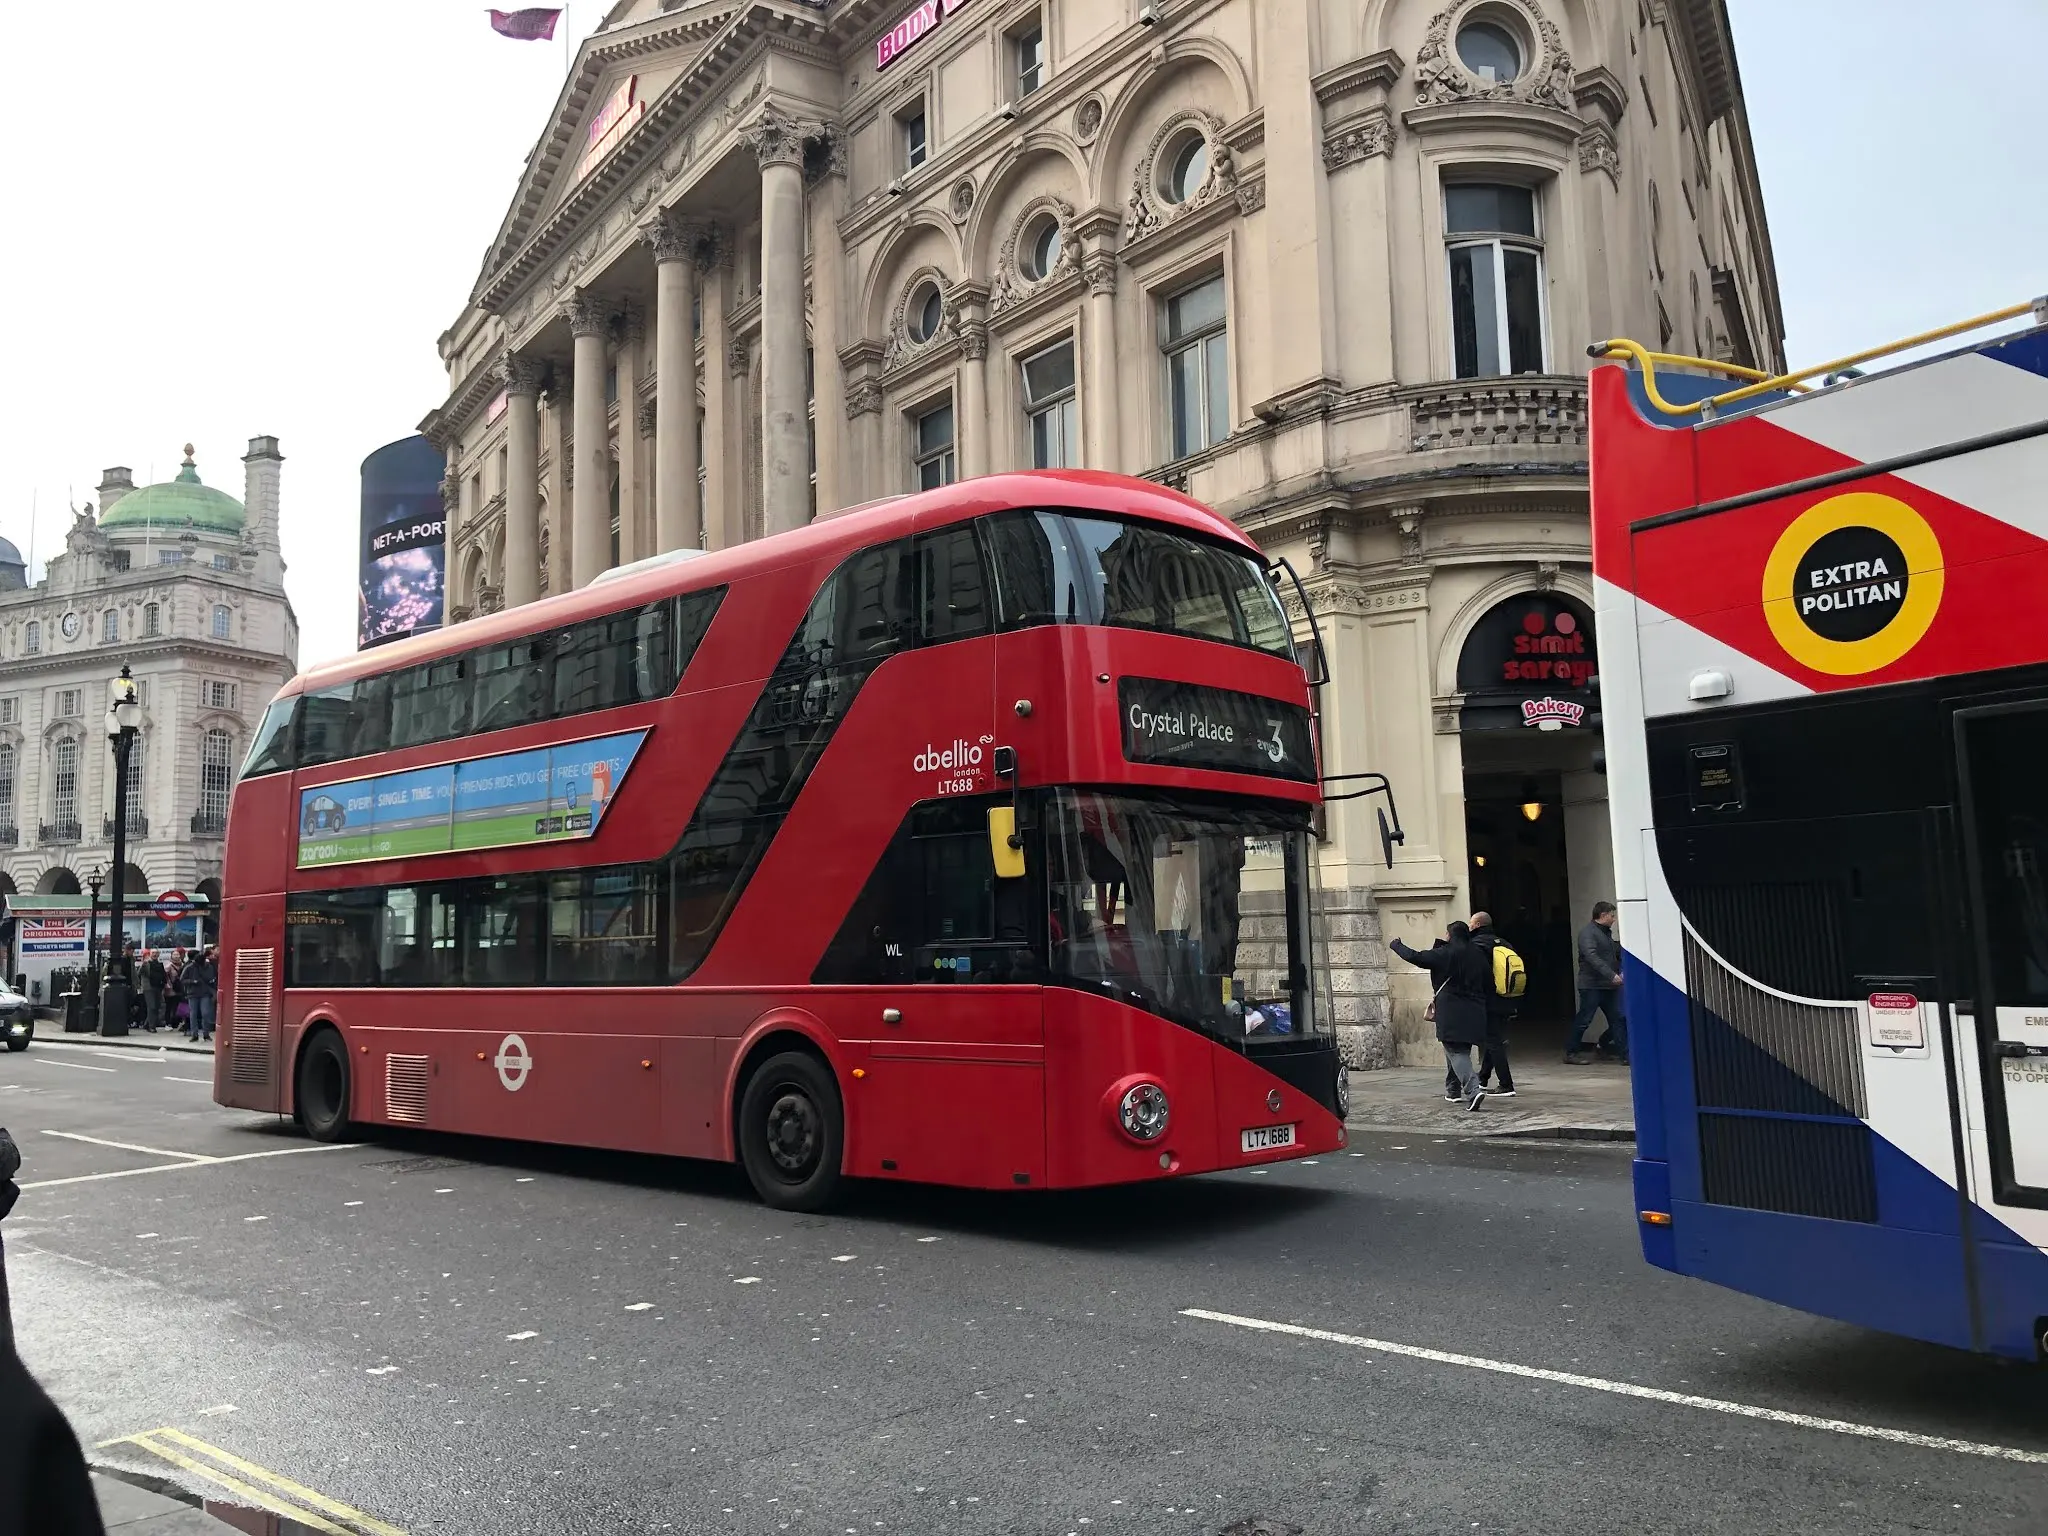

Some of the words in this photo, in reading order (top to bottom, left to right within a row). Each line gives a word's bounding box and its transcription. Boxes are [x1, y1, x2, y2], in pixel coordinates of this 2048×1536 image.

[877, 0, 938, 68] BODY
[1810, 557, 1889, 588] EXTRA
[1802, 581, 1901, 615] POLITAN
[1523, 698, 1583, 720] Bakery
[1130, 704, 1186, 738] Crystal
[1190, 713, 1233, 742] Palace
[1266, 719, 1284, 763] 3
[913, 738, 982, 772] abellio
[557, 764, 579, 779] FREE
[953, 767, 980, 777] london
[938, 778, 973, 794] LT688
[24, 929, 61, 937] ORIGINAL
[885, 943, 903, 957] WL
[2004, 1061, 2036, 1072] PULL
[2004, 1071, 2022, 1082] TO
